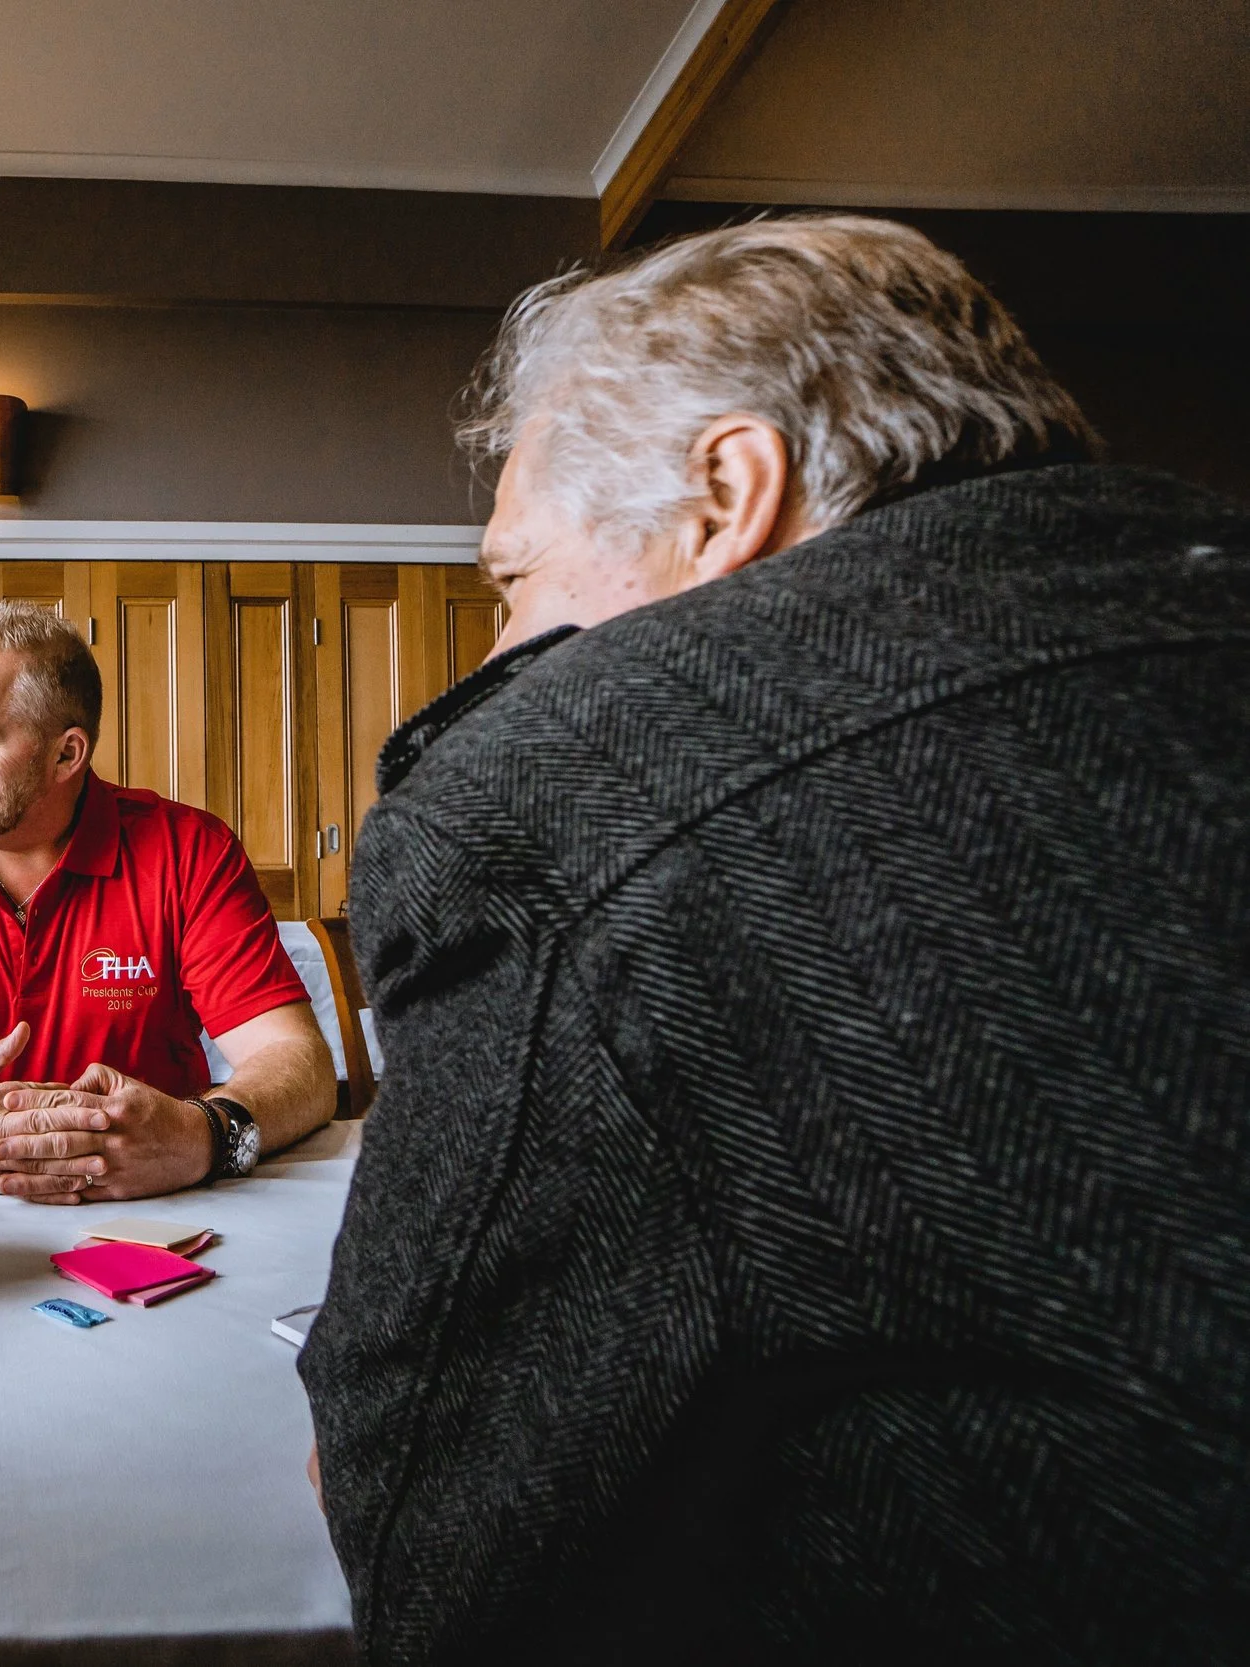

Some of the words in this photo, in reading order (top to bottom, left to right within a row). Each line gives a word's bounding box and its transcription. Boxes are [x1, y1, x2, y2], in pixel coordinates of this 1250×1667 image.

[96, 955, 156, 980] THA
[82, 986, 134, 997] Presidents
[137, 985, 158, 997] Cup
[107, 1000, 133, 1010] 2016
